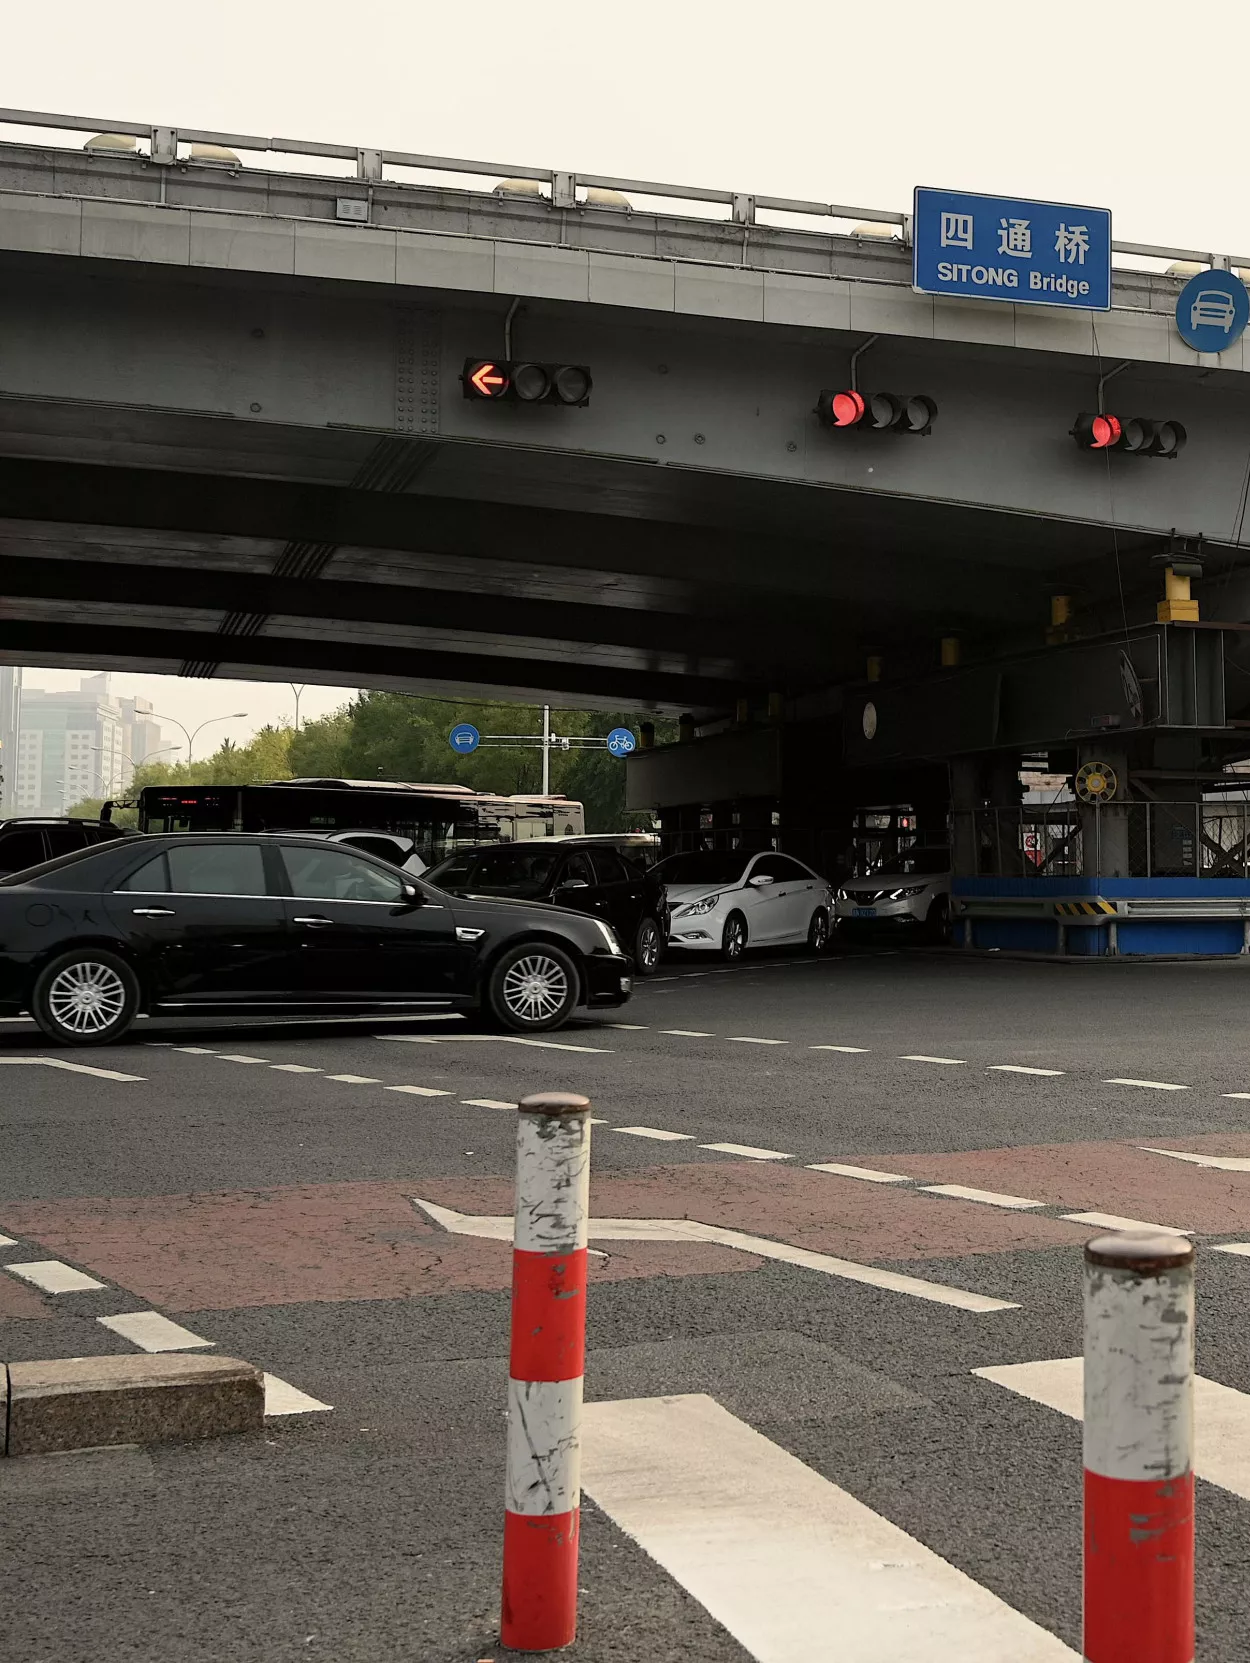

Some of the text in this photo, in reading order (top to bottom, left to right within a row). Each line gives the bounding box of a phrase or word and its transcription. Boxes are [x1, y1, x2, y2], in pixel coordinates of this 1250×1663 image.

[940, 211, 1090, 265] 四通桥
[937, 262, 1090, 298] SITONG Bridge
